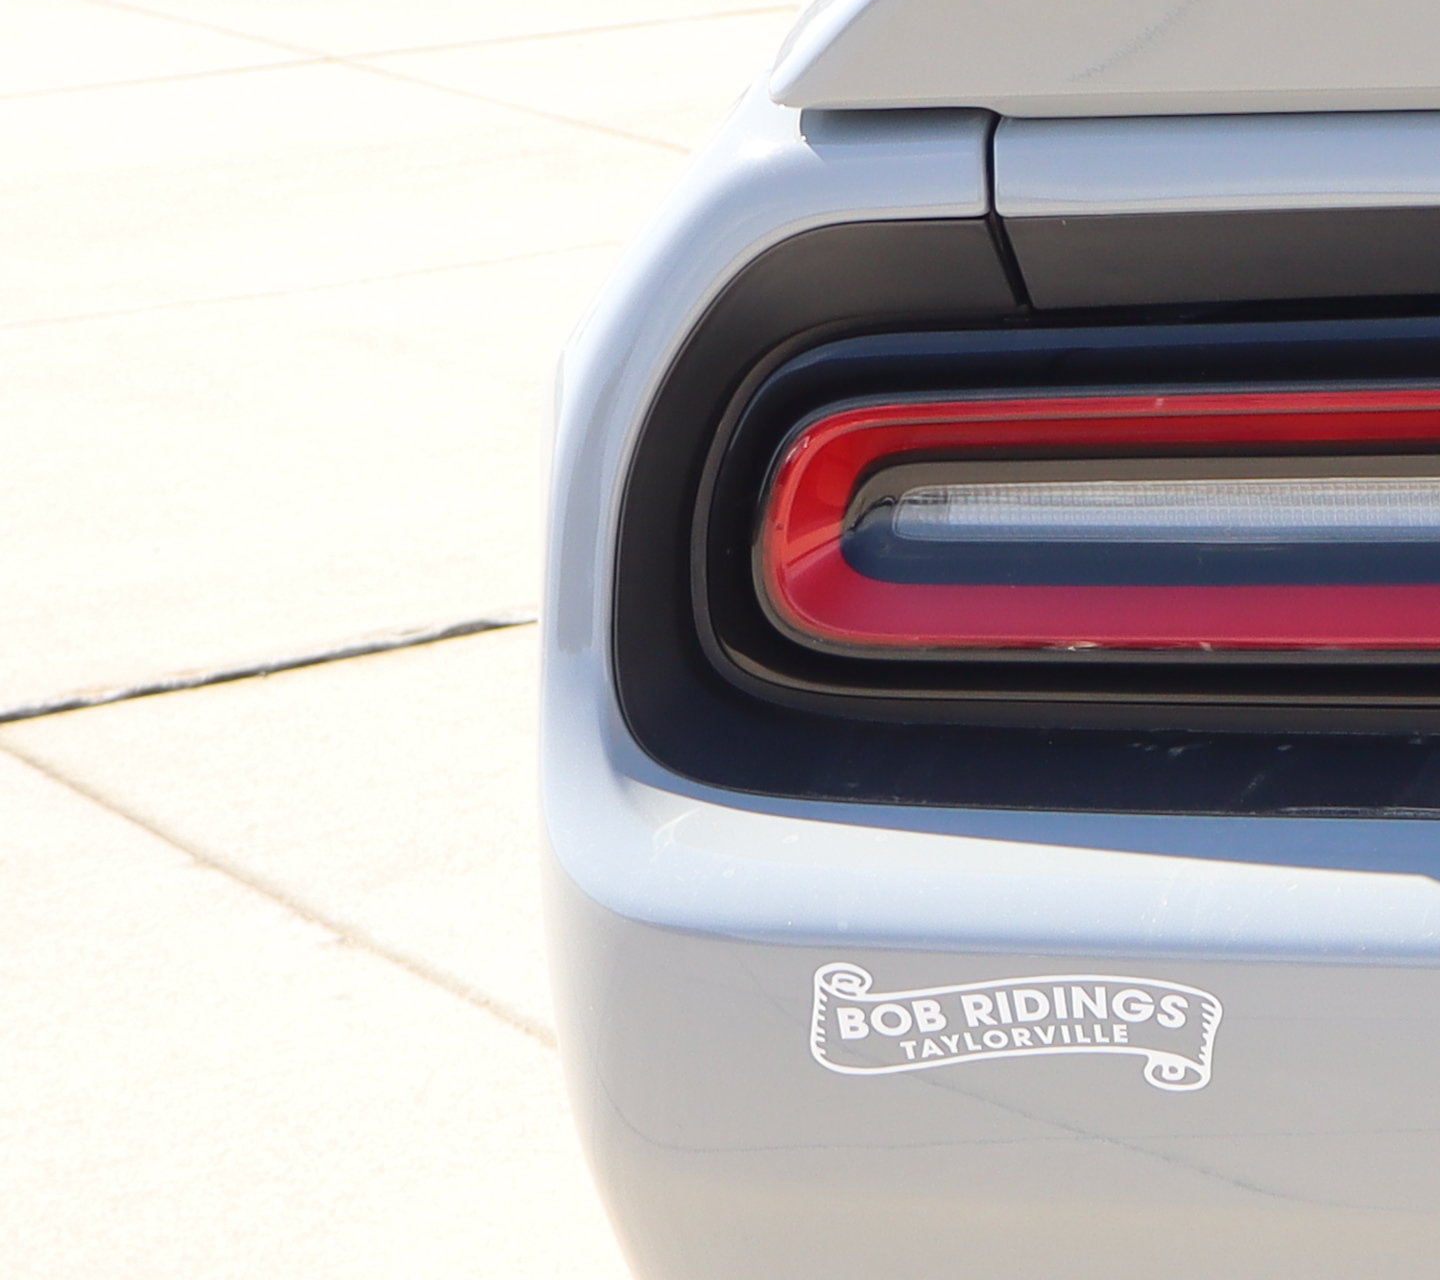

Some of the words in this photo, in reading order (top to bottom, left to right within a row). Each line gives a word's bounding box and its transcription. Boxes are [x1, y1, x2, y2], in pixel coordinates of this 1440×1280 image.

[836, 999, 947, 1039] BOB
[961, 986, 1189, 1029] RIDINGS
[900, 1024, 1129, 1060] TAYLORVILLE
